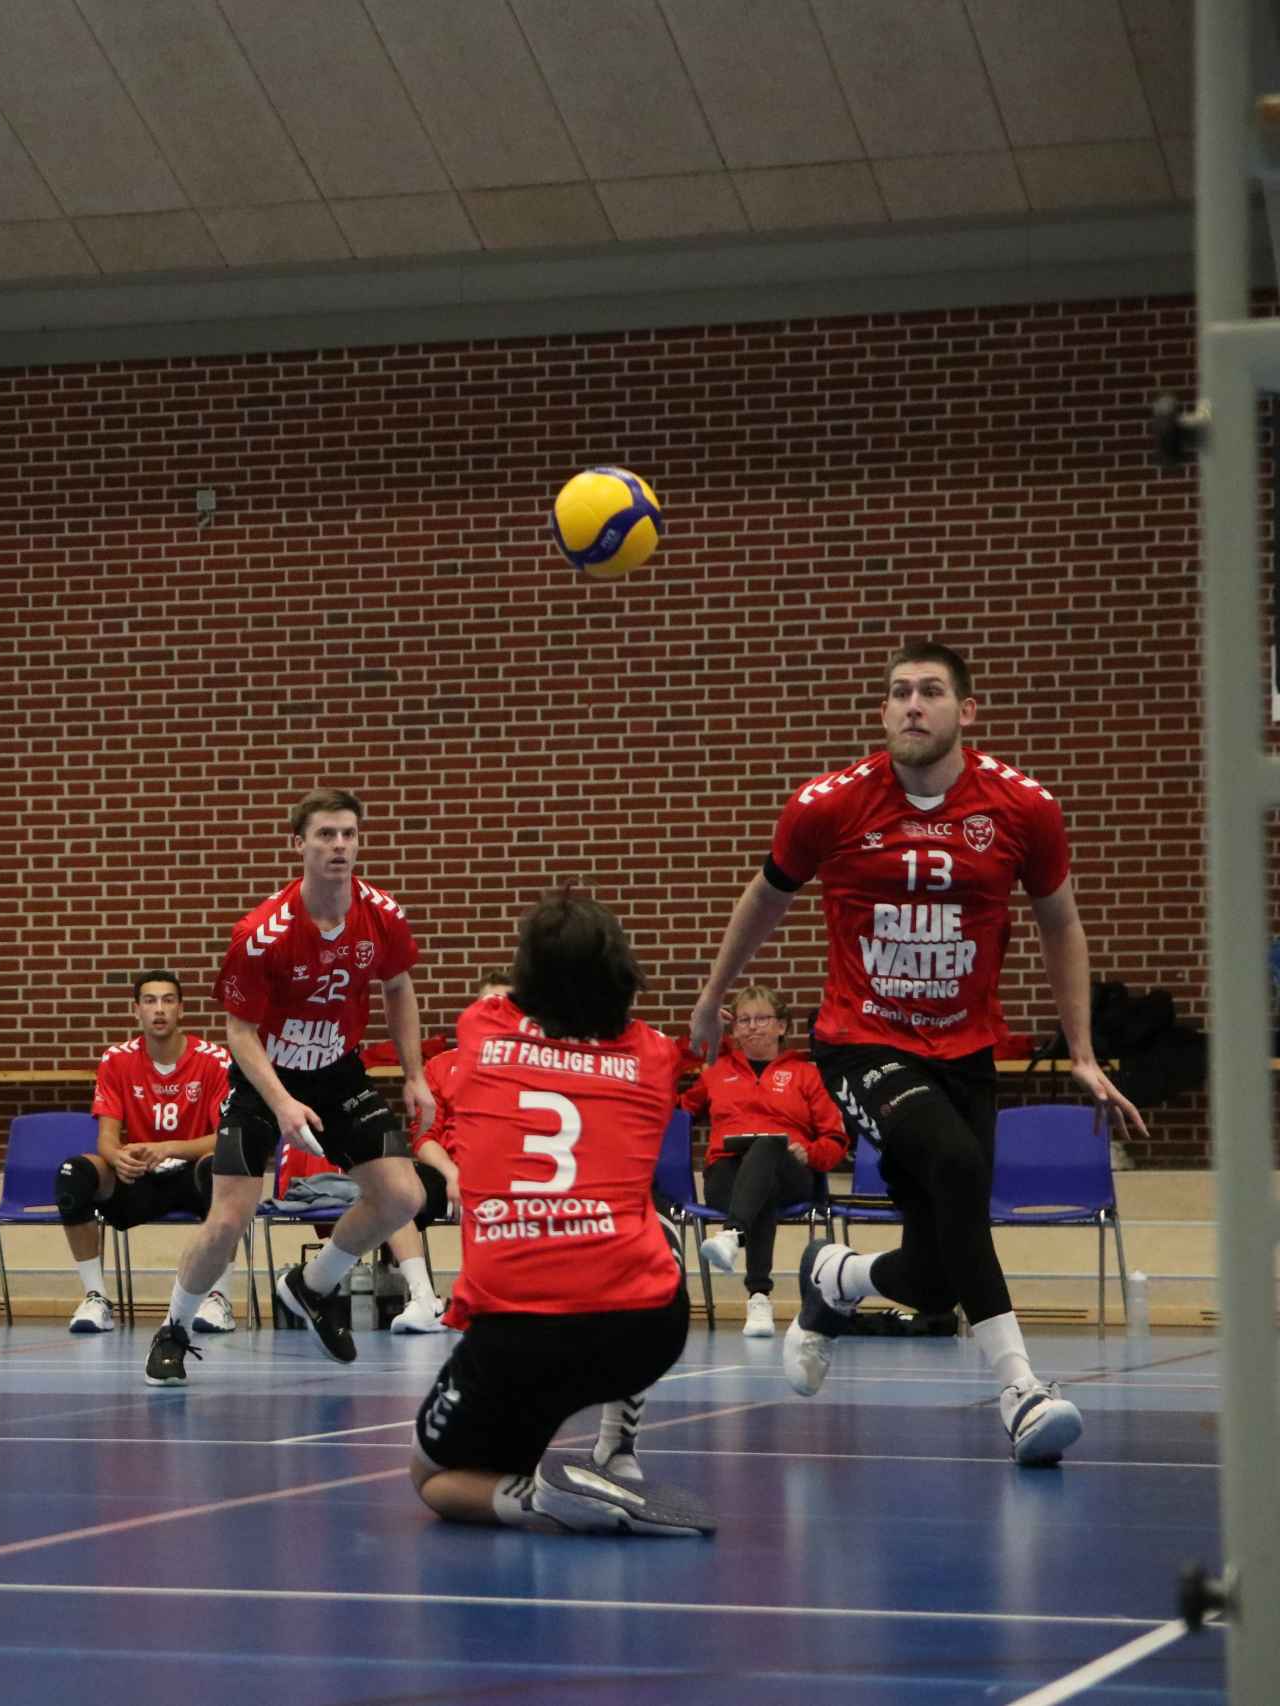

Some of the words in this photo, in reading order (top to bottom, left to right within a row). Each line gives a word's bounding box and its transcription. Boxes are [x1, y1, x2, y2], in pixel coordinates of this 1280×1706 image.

[927, 823, 953, 836] LCC
[901, 848, 953, 892] 13
[873, 903, 962, 942] BLUE
[859, 935, 977, 979] WATER
[306, 968, 350, 1004] 22
[870, 977, 960, 999] SHIPPING
[266, 1032, 346, 1071] WATER
[481, 1039, 517, 1065] DET
[517, 1041, 596, 1075] FAGLIGE
[599, 1054, 638, 1083] HUS
[152, 1102, 179, 1132] 18
[510, 1090, 582, 1193] 3
[514, 1199, 613, 1217] TOYOTA
[474, 1216, 541, 1243] Louis
[547, 1214, 617, 1238] Lund
